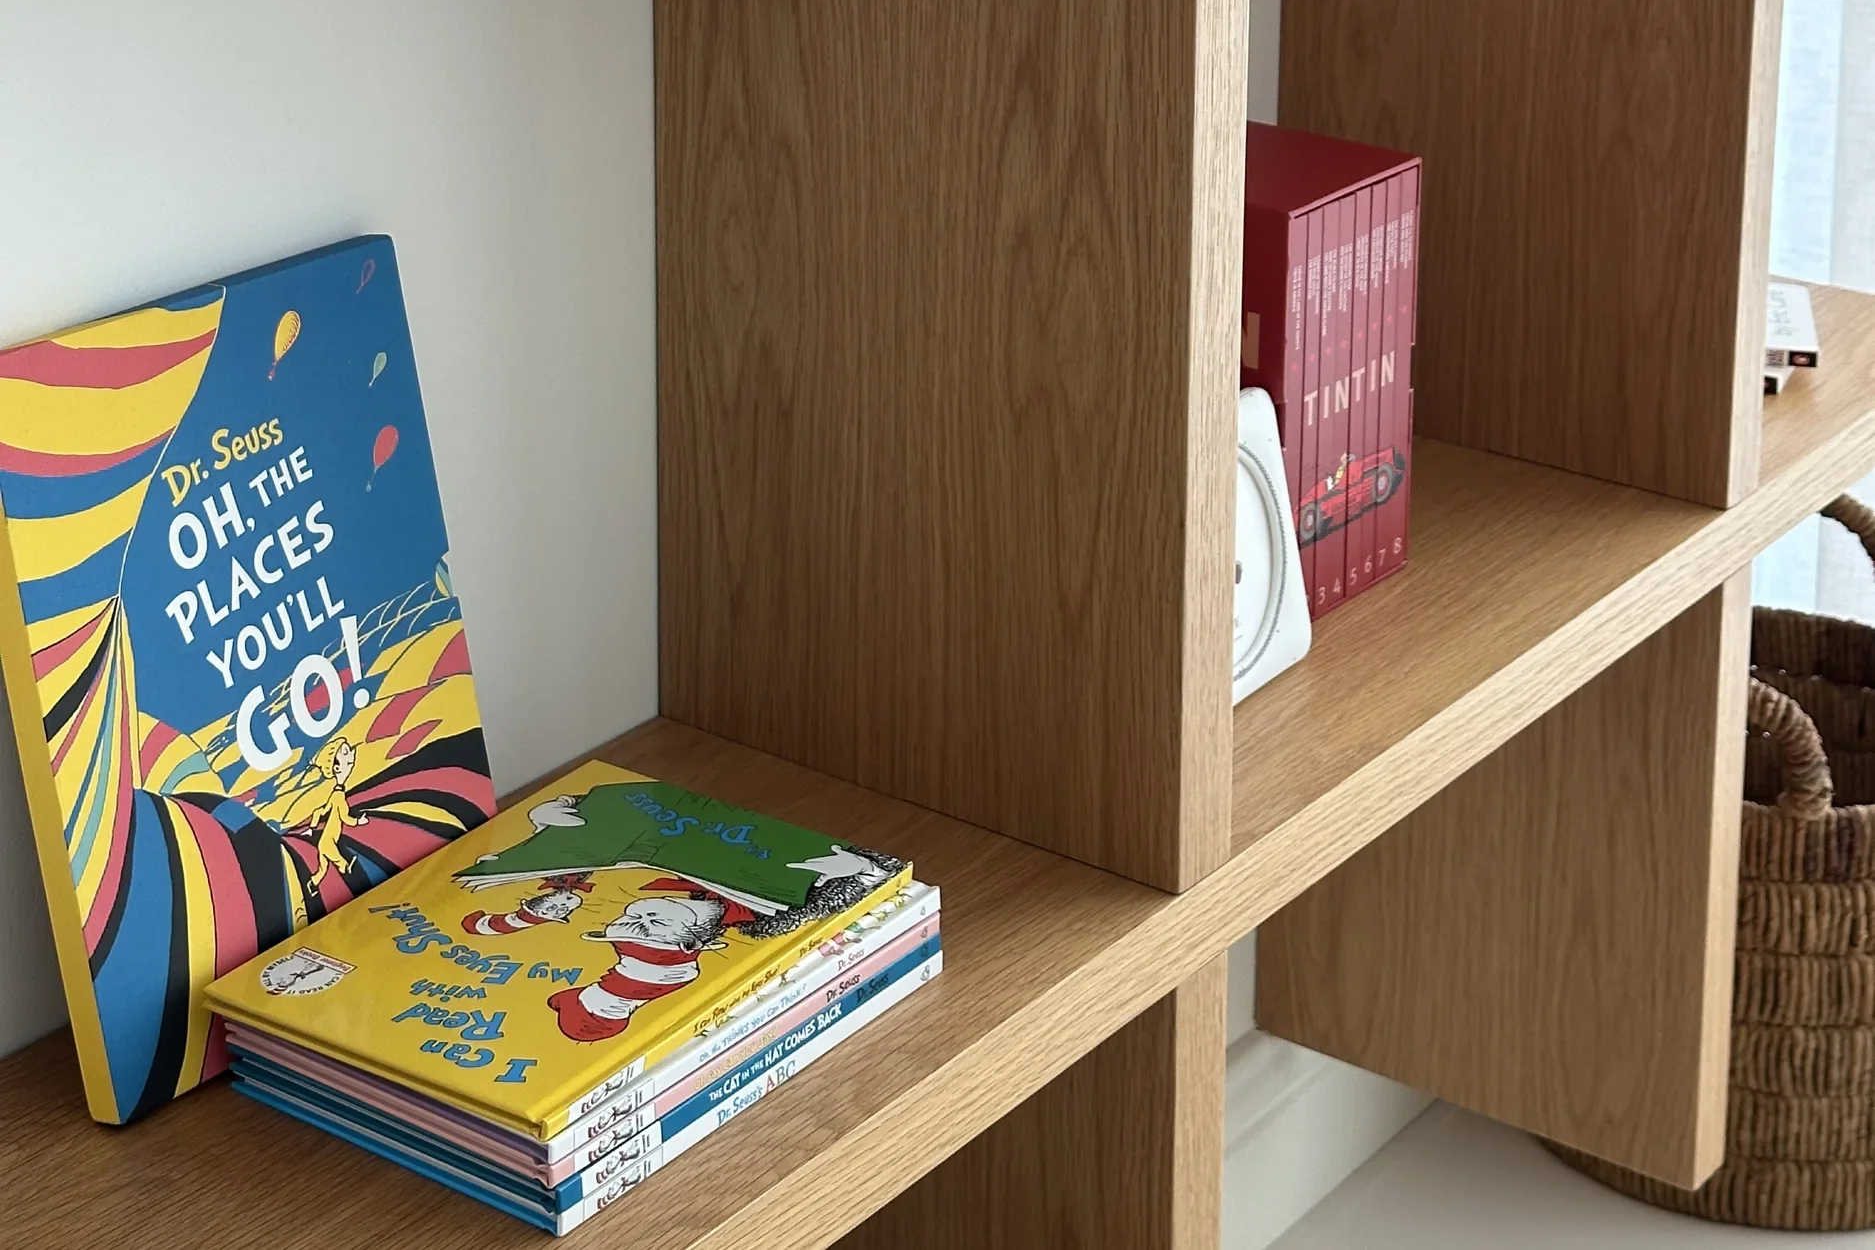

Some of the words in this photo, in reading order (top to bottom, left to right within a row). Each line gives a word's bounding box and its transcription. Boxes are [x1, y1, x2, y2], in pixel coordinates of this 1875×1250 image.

[1304, 349, 1396, 427] TINTIN
[161, 458, 209, 508] Dr.
[211, 417, 284, 471] Seuss
[168, 481, 257, 571] OH,
[248, 445, 314, 508] THE
[164, 499, 335, 645] PLACES
[1318, 586, 1326, 605] 3
[1332, 577, 1342, 593] 4
[1349, 567, 1357, 585] 5
[1364, 554, 1373, 573] 6
[1379, 548, 1387, 566] 7
[1393, 536, 1402, 555] 8
[205, 575, 346, 689] YOU'LL
[236, 614, 371, 772] GO!
[623, 792, 701, 838] Seuss
[701, 821, 757, 844] Dr.
[368, 902, 453, 954] Shut!
[440, 944, 524, 985] Eyes
[527, 961, 584, 985] My
[408, 978, 488, 1003] with
[826, 989, 838, 1003] Dr.
[839, 974, 861, 994] Seuss
[390, 1002, 507, 1041] Read
[420, 1038, 495, 1068] Can
[493, 1058, 538, 1083] I
[708, 1087, 724, 1102] THE
[723, 1072, 741, 1094] CAT
[741, 1068, 750, 1081] IN
[750, 1059, 765, 1074] THE
[764, 1044, 784, 1066] HAT
[784, 1019, 816, 1051] COMES
[816, 1002, 843, 1030] BACK
[716, 1109, 732, 1126] Dr.
